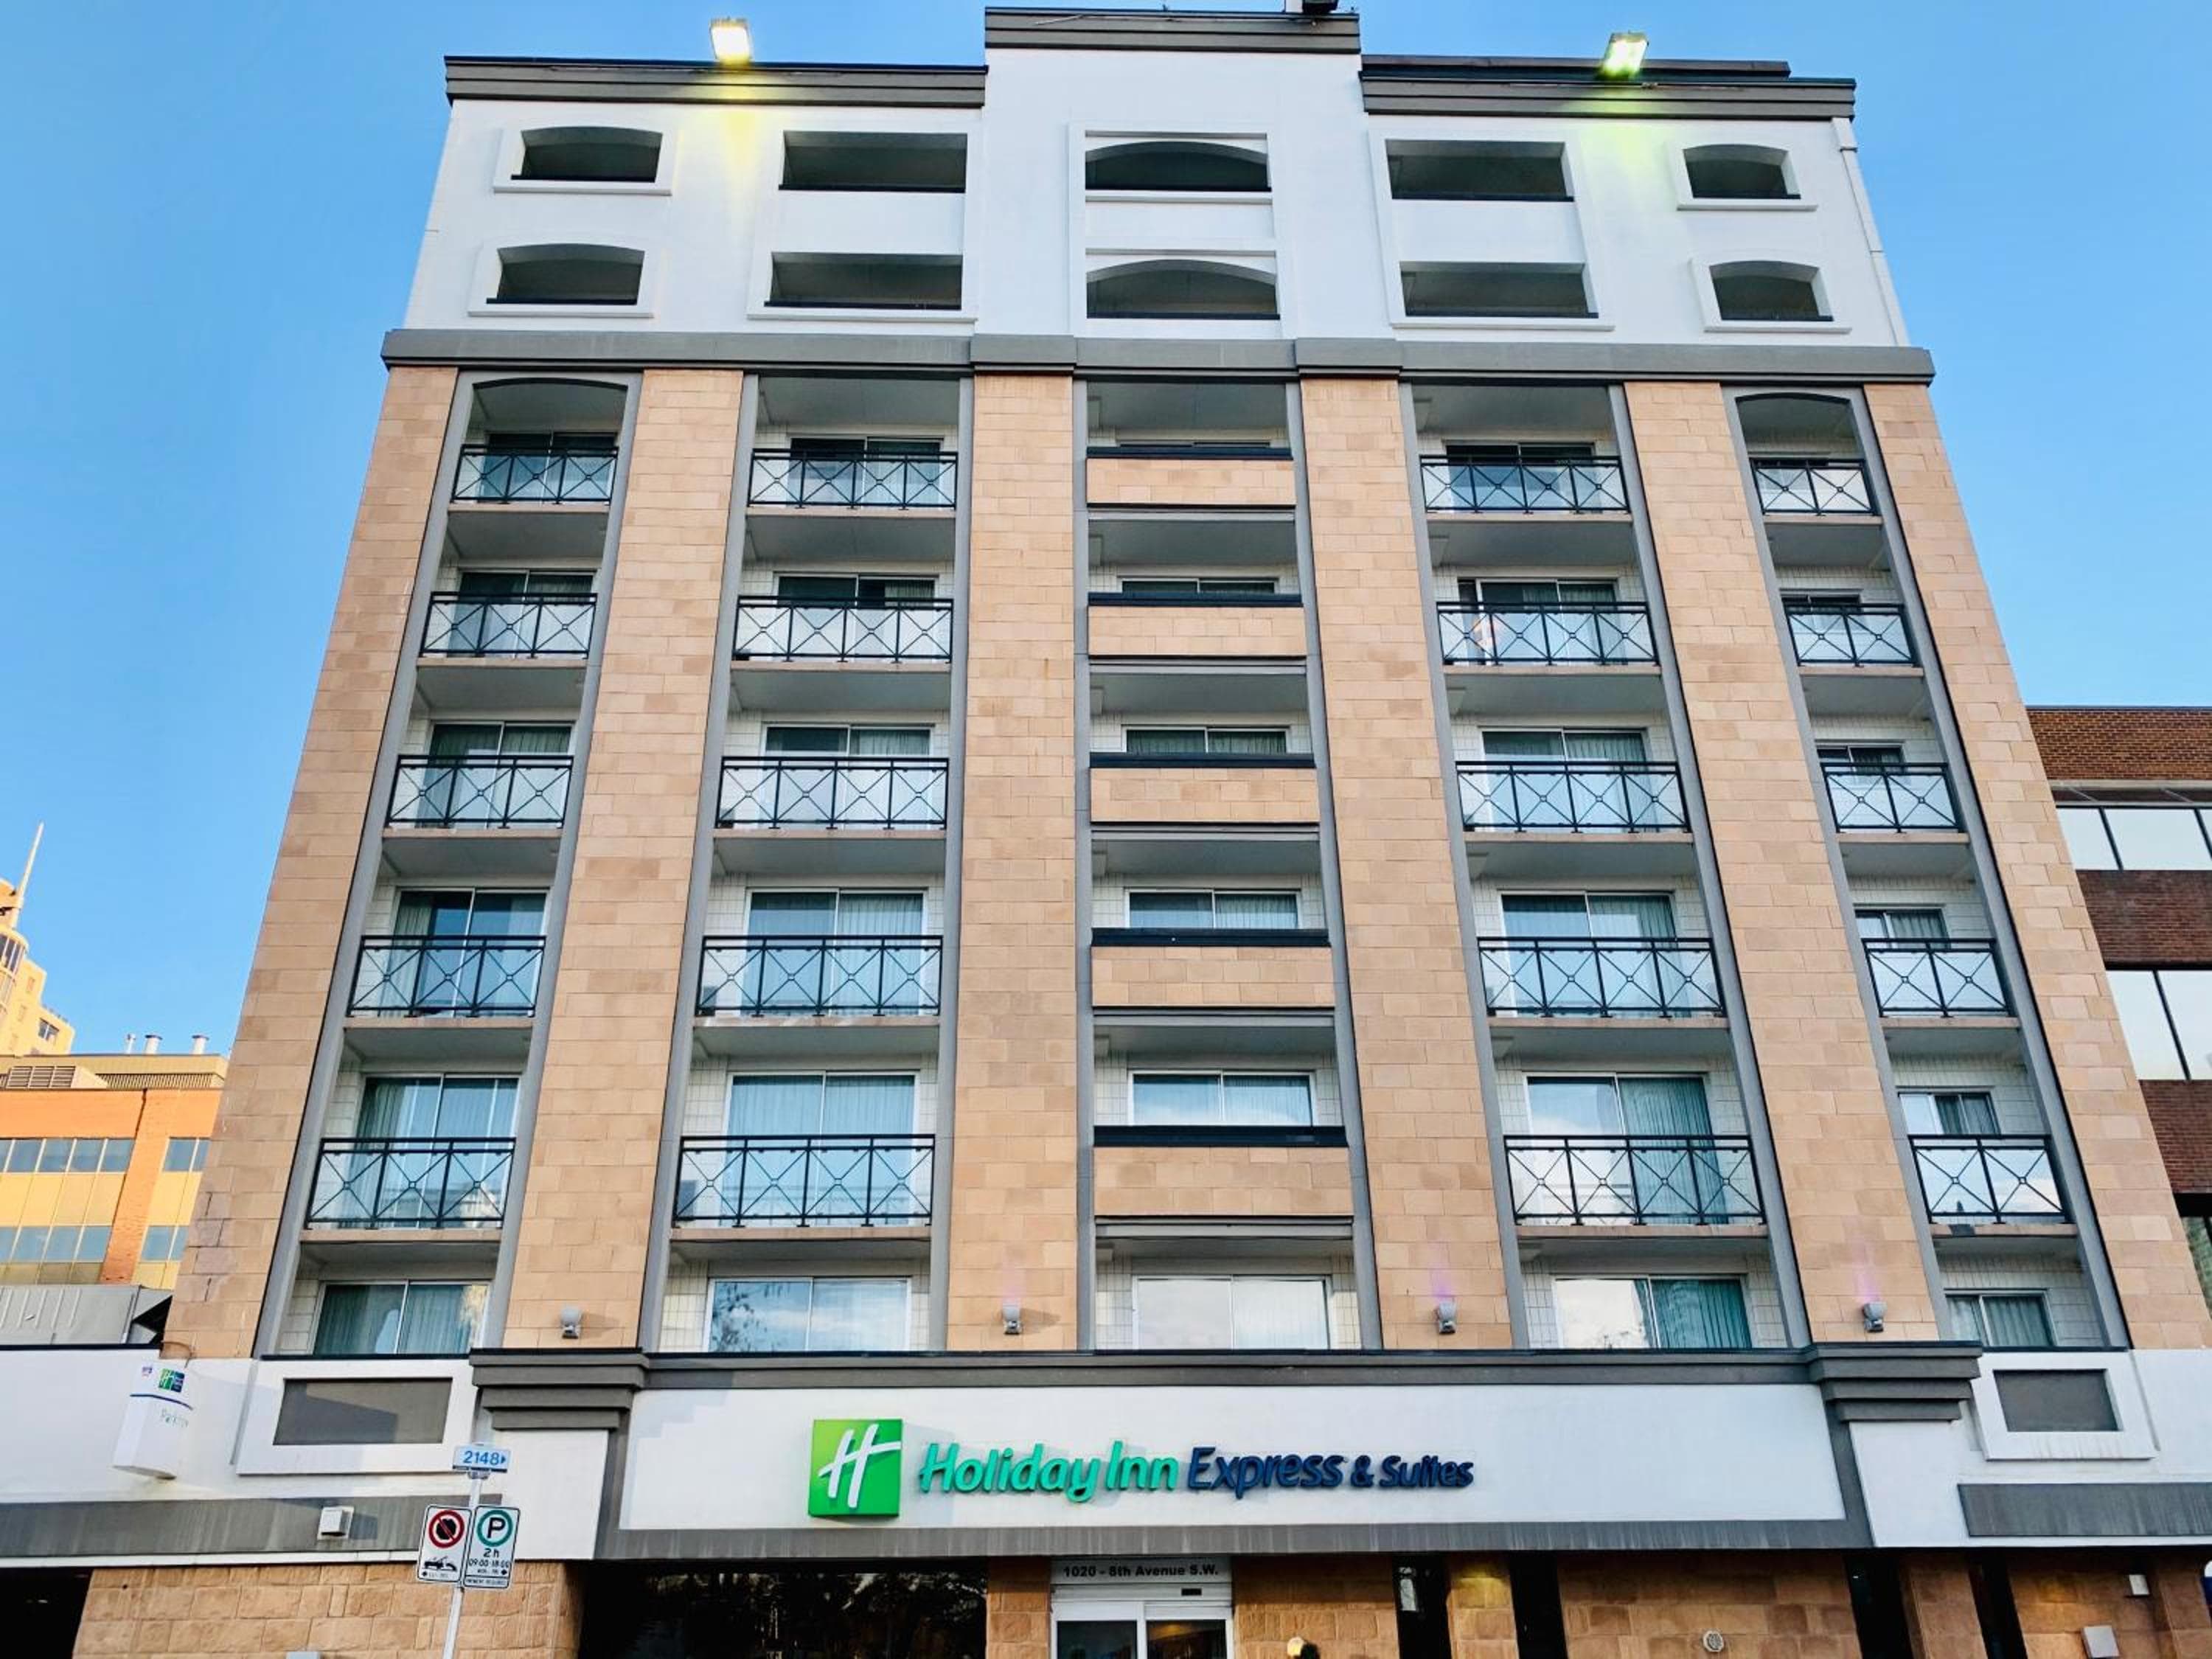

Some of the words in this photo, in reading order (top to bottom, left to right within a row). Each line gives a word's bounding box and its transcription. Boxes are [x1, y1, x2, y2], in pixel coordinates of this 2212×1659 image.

[462, 1450, 500, 1467] 2148
[919, 1442, 1100, 1503] Holiday
[1106, 1440, 1180, 1492] Inn
[1187, 1446, 1345, 1500] Express
[1350, 1454, 1375, 1488] &
[1379, 1454, 1474, 1489] Suites
[1063, 1565, 1096, 1577] 1020
[1108, 1565, 1131, 1577] 8th
[1135, 1565, 1186, 1577] Avenue
[1189, 1563, 1219, 1576] S.W.
